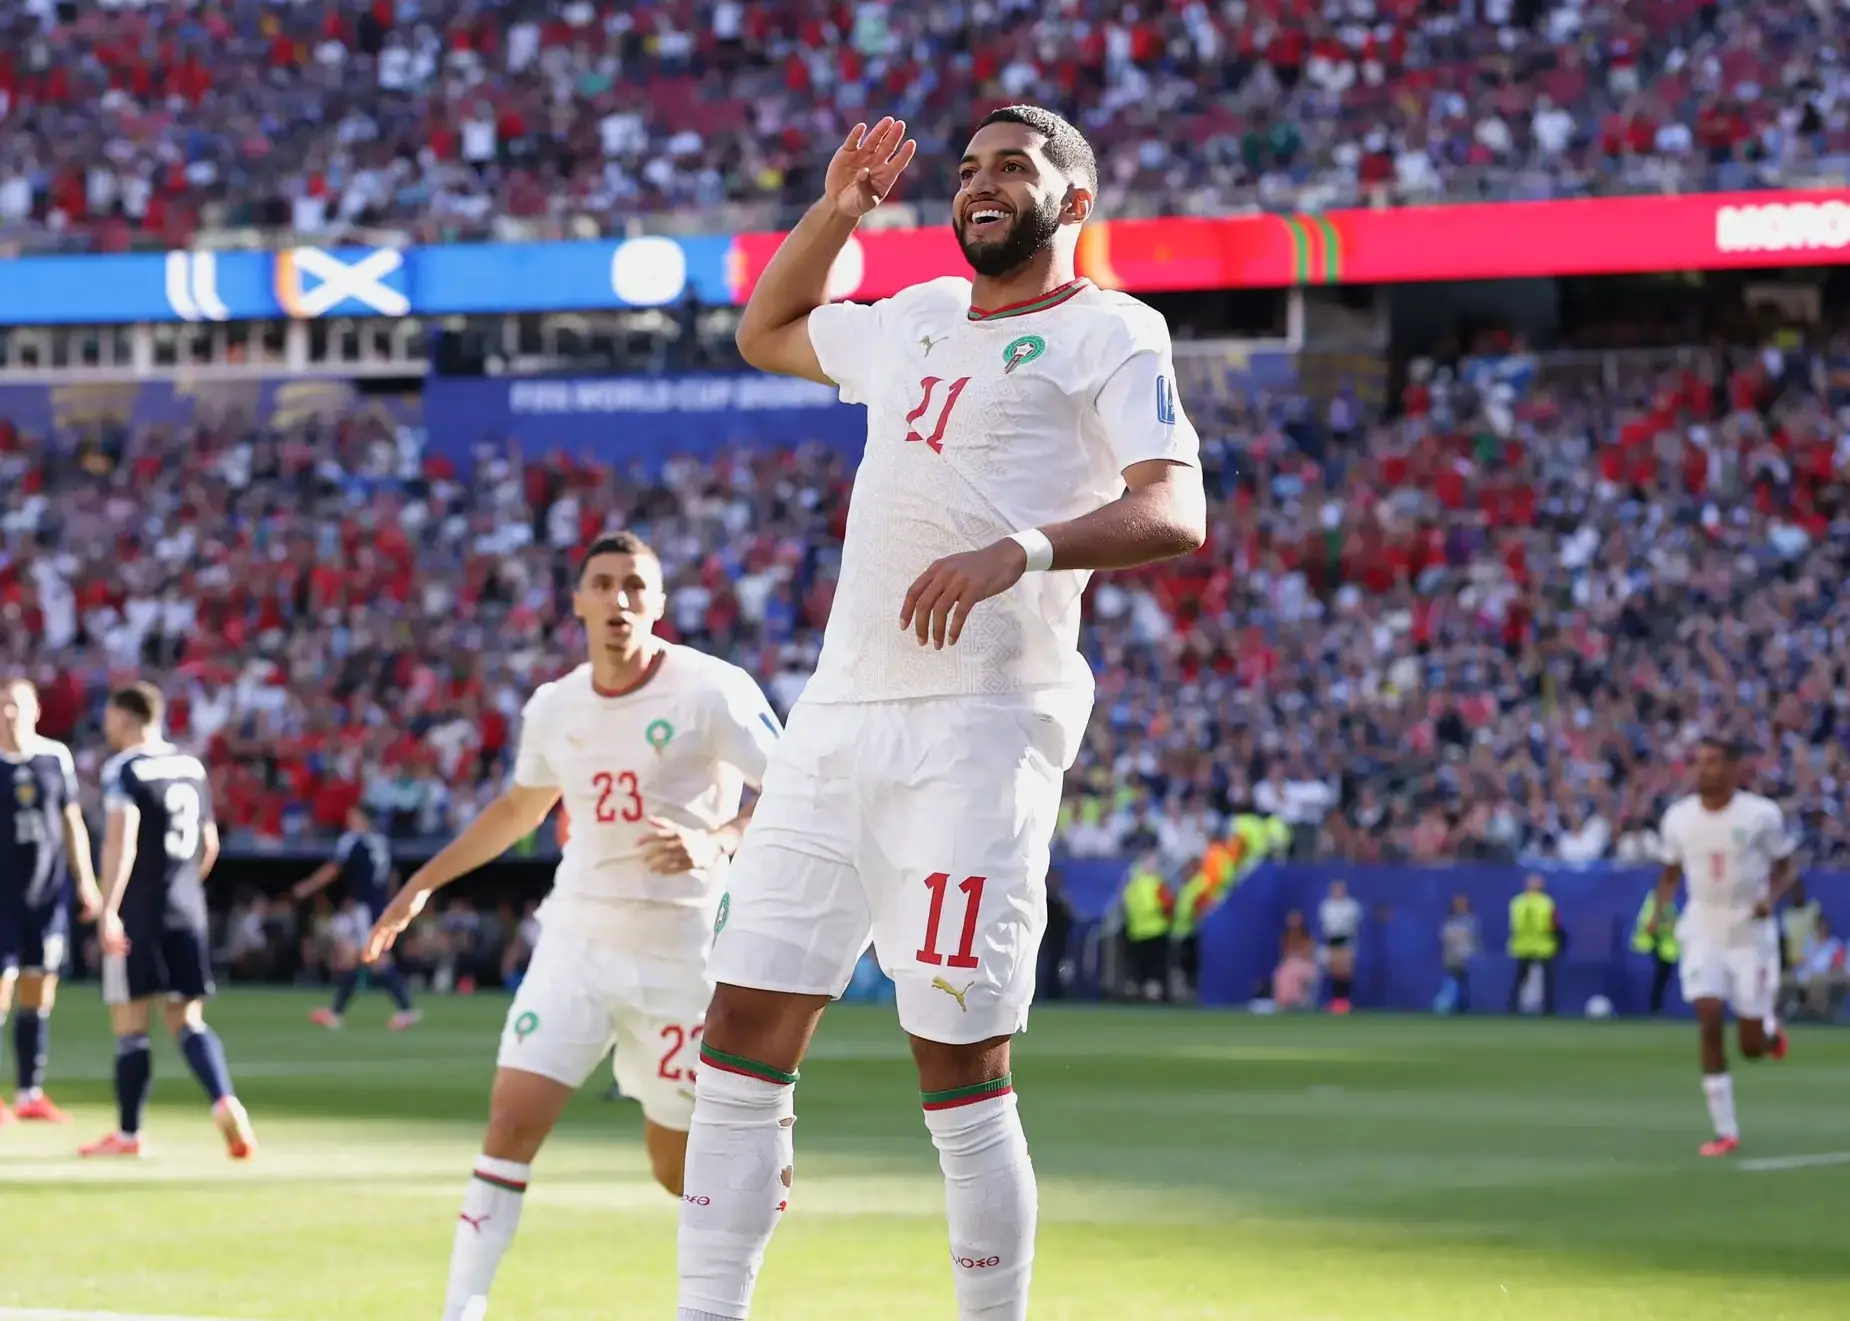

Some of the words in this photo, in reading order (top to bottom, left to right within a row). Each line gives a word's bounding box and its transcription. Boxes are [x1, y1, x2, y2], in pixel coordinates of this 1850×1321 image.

[164, 782, 200, 860] 3
[593, 770, 643, 823] 23
[916, 872, 987, 968] 11
